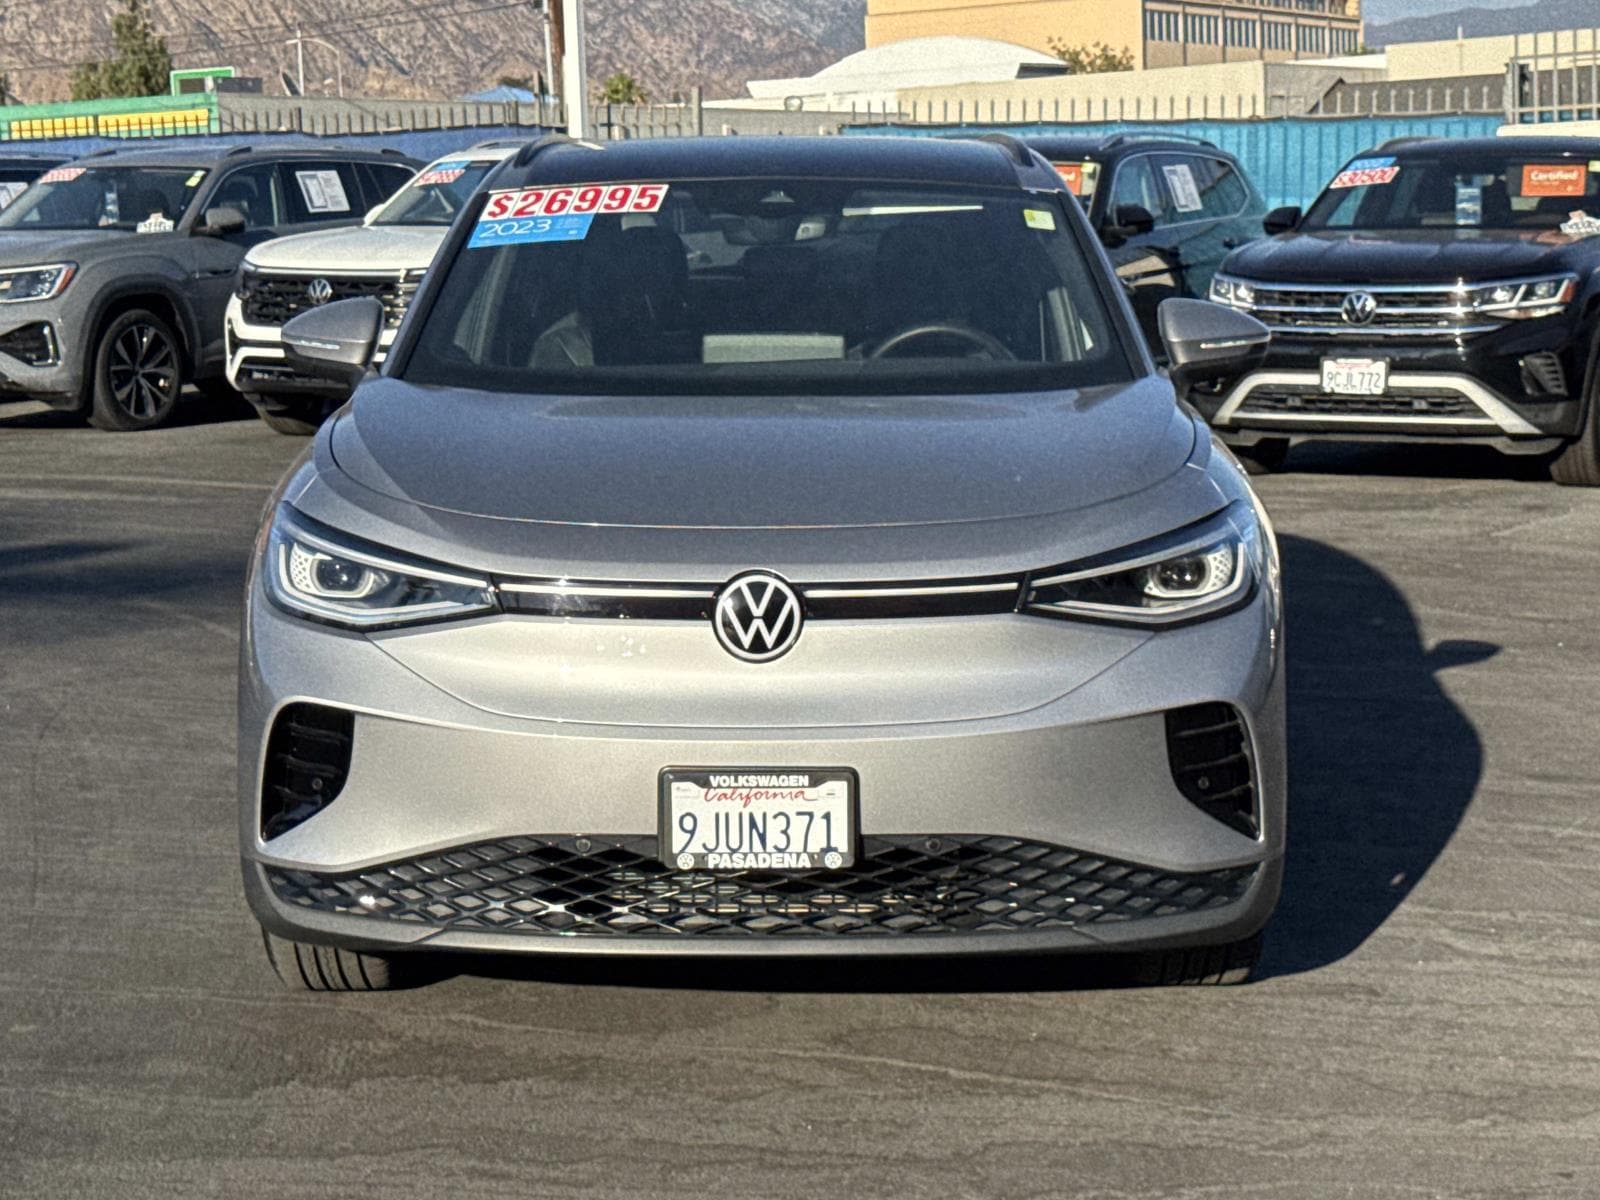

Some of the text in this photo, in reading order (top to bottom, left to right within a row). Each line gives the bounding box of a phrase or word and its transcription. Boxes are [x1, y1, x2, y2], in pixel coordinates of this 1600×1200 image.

[487, 185, 664, 218] $26995
[479, 218, 553, 238] 2023
[716, 575, 800, 657] VW
[709, 775, 809, 787] VOLKSWAGEN
[703, 787, 818, 808] California
[678, 811, 839, 853] 9JUN371
[707, 853, 812, 869] PASADENA
